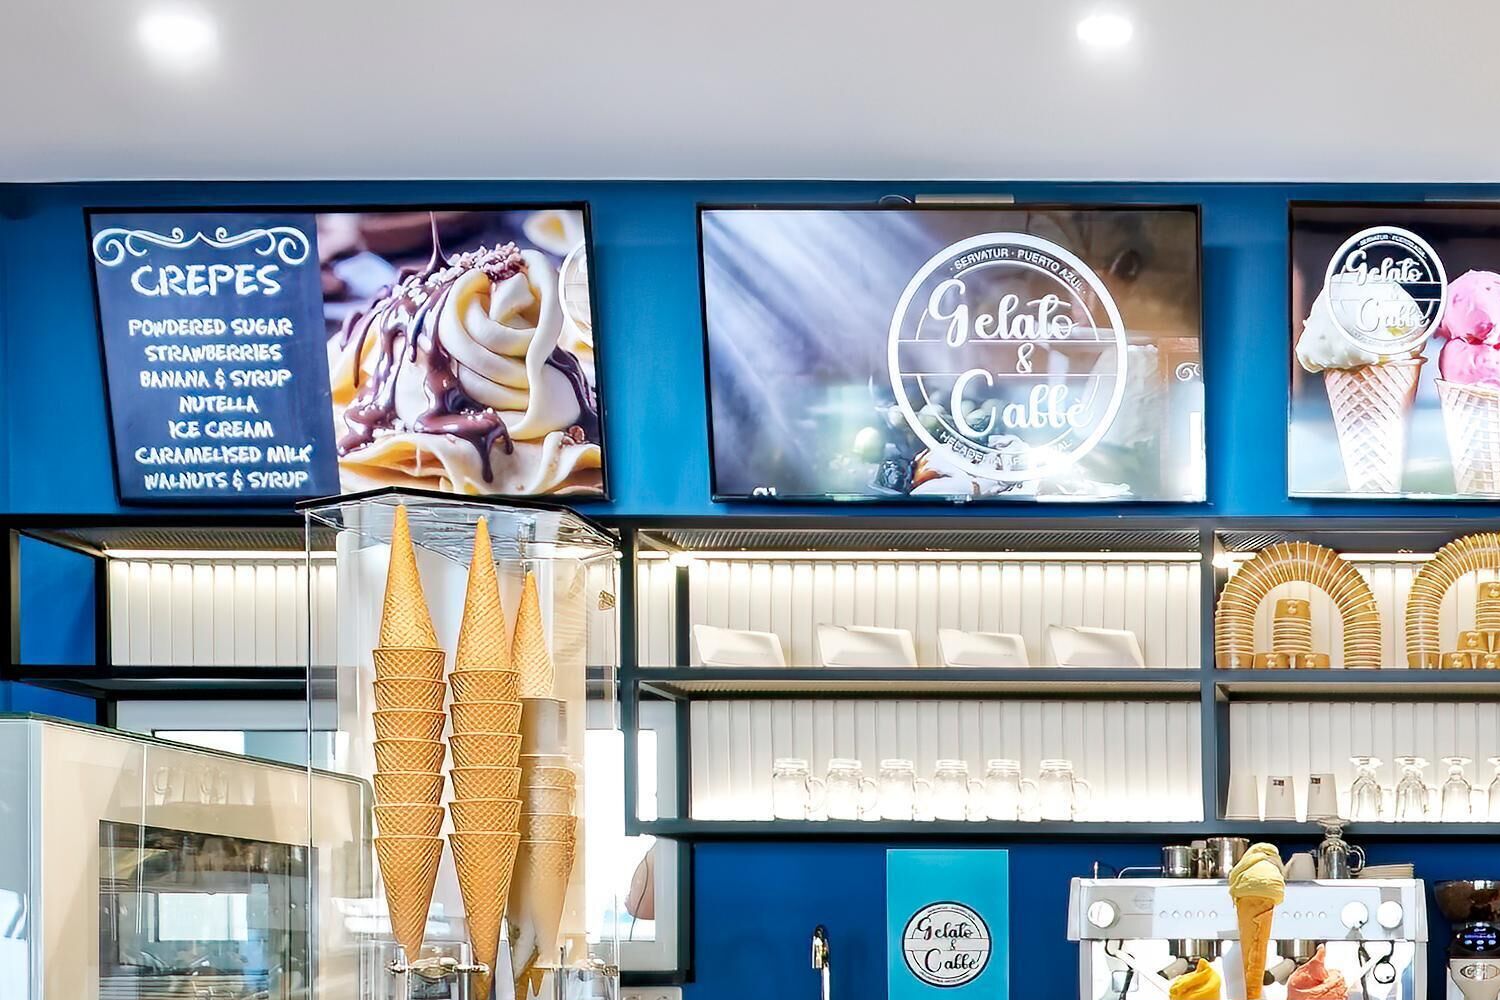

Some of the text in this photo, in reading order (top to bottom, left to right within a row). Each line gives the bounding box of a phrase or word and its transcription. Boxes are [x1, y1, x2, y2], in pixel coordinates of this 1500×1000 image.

[953, 247, 1084, 293] SERVATUR PUERTO AZUL
[1345, 250, 1423, 286] Gelato
[131, 264, 281, 296] CREPES
[927, 278, 1079, 347] Gelato
[128, 317, 293, 336] POWDERED SUGAR
[144, 343, 282, 362] STRAWBERRIES
[1016, 342, 1035, 374] &
[140, 368, 292, 390] BANANA & SYRUP
[179, 395, 259, 413] NUTELLA
[168, 420, 274, 439] ICE CREAM
[134, 444, 313, 465] CARAMELISED MILK
[144, 469, 309, 491] WALNUTS & SYRUP
[917, 915, 973, 941] Gelato
